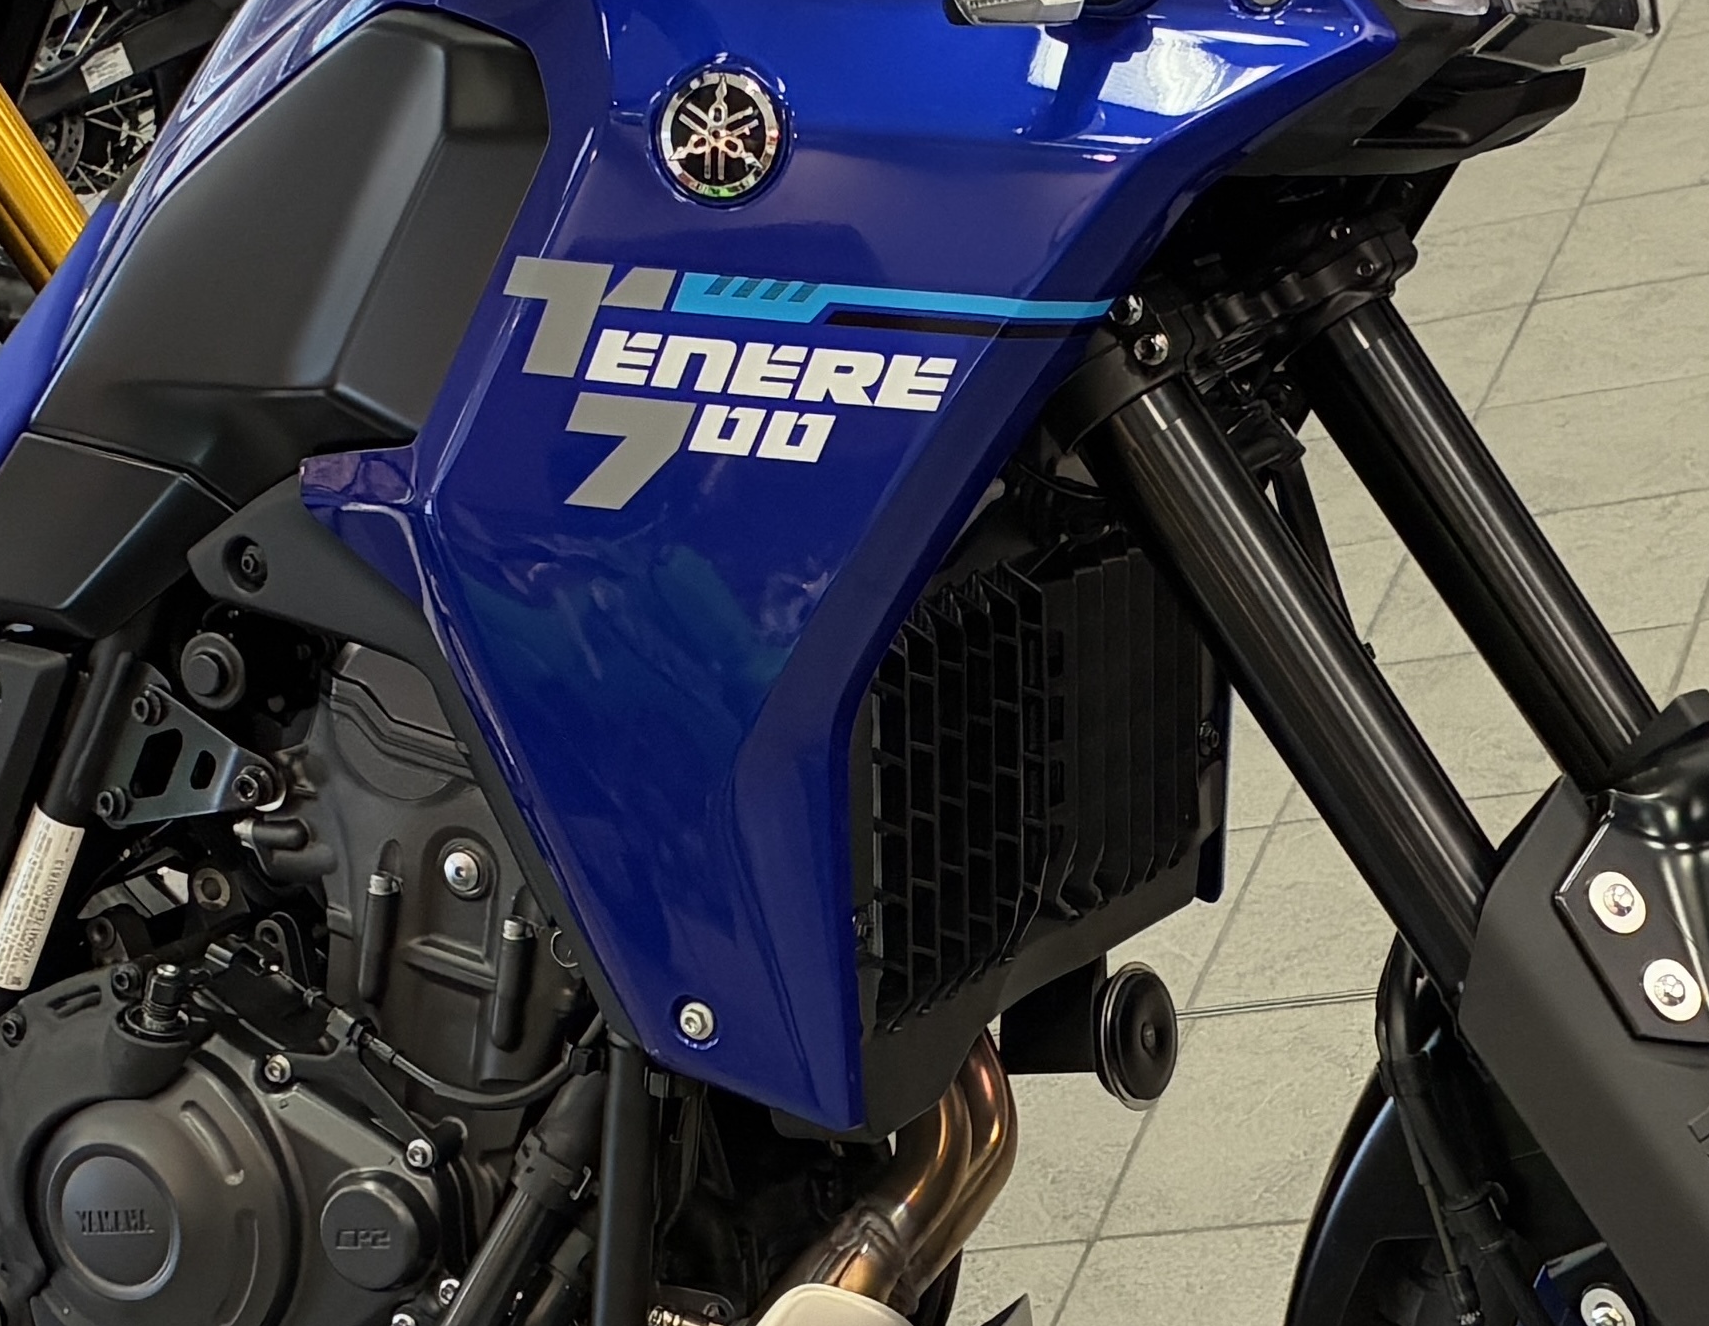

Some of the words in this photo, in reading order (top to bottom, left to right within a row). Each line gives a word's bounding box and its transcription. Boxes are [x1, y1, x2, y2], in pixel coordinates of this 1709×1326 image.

[503, 256, 958, 413] TENERE
[564, 392, 837, 511] 700
[74, 1208, 154, 1235] YAMAHA
